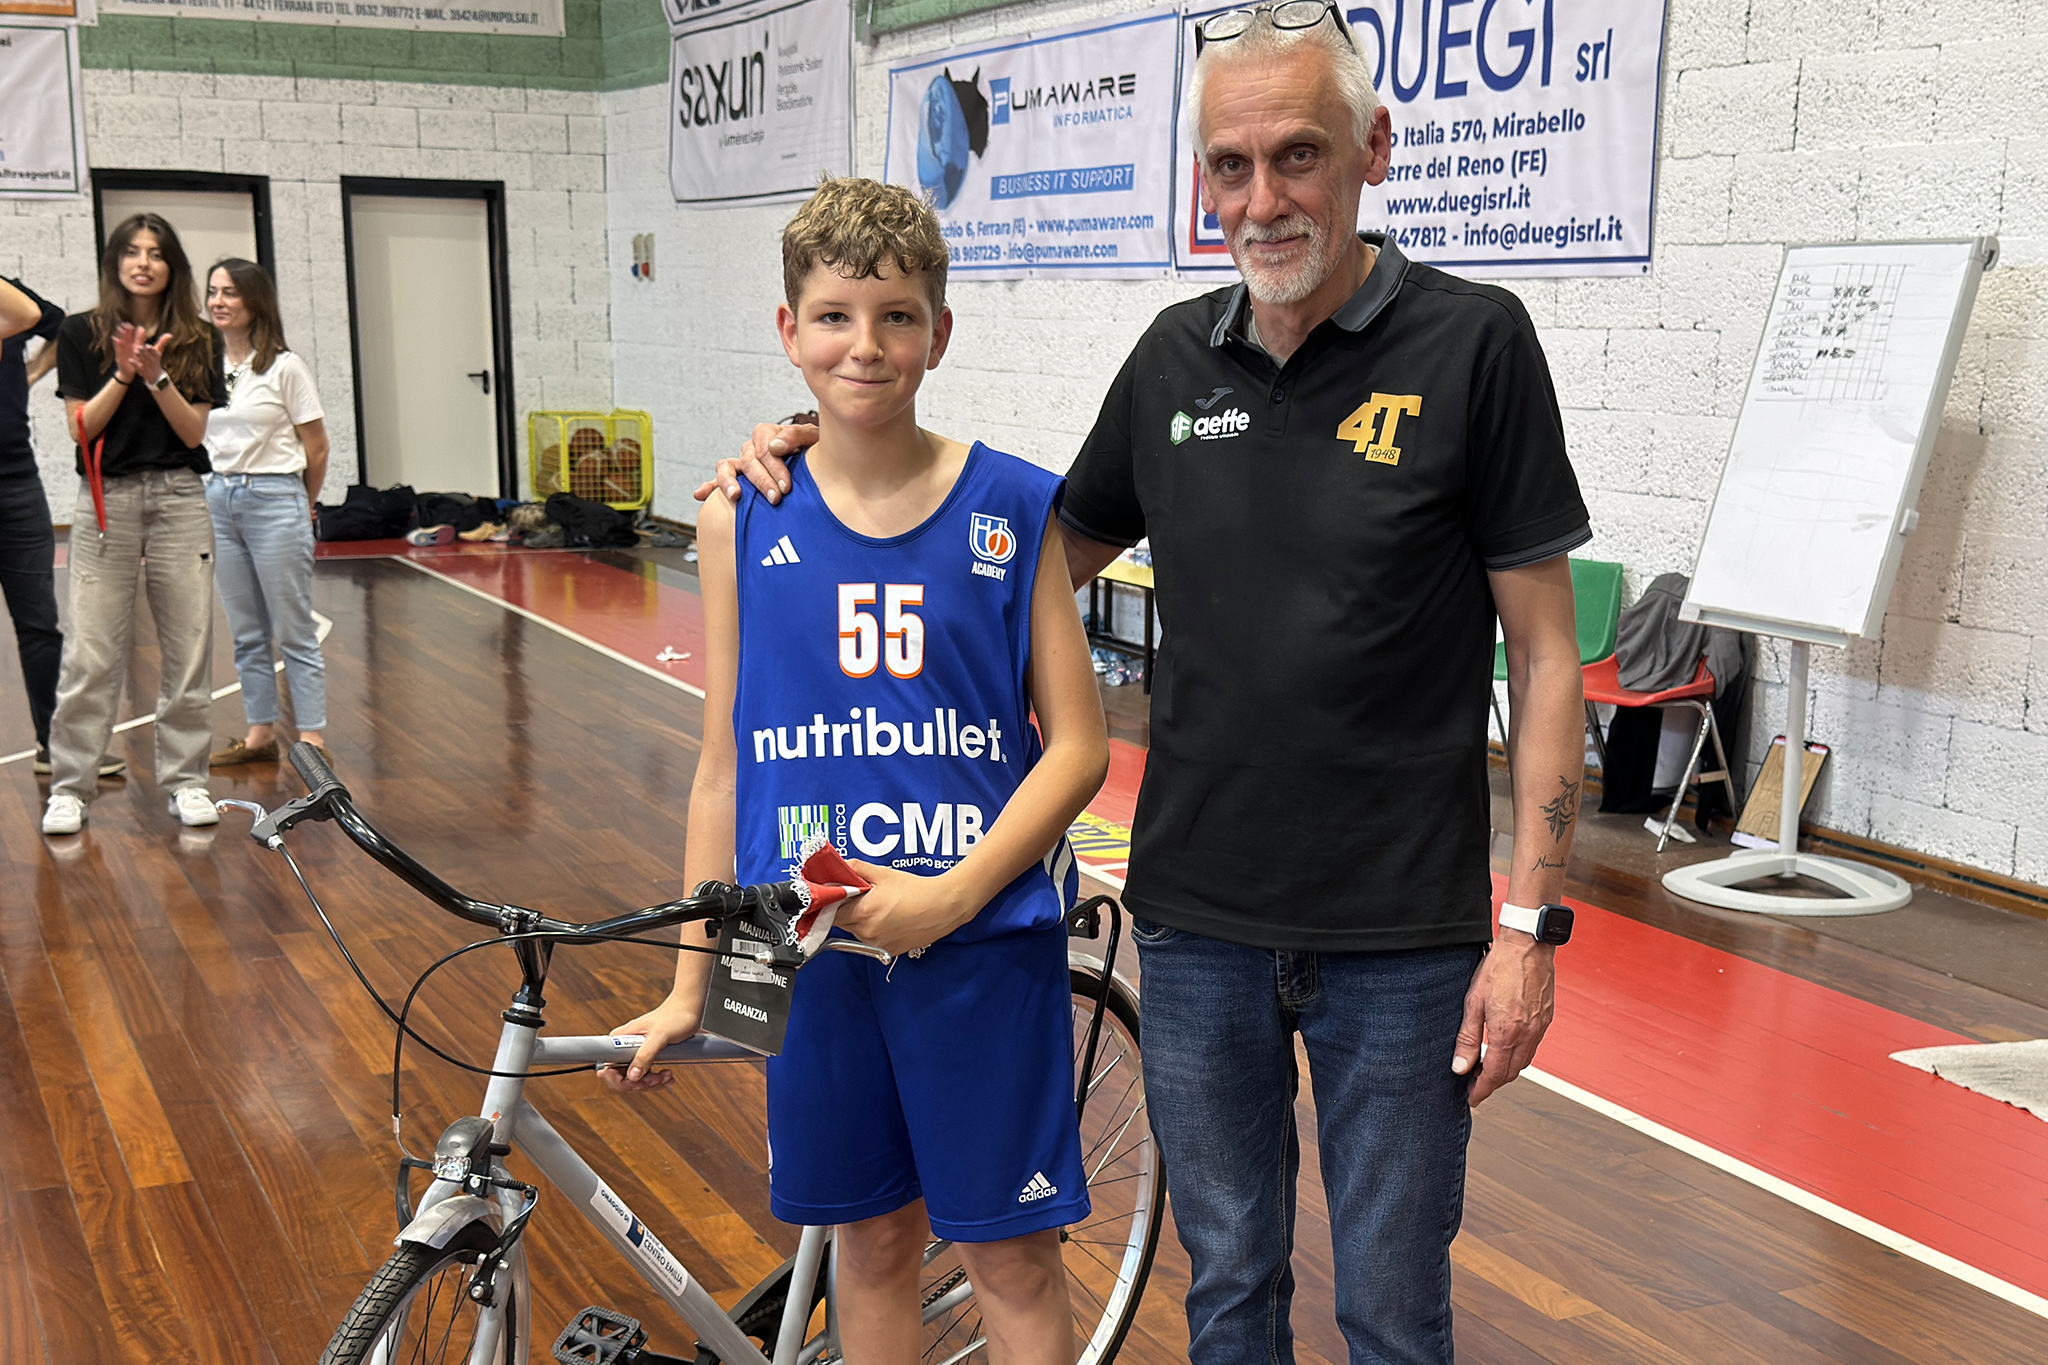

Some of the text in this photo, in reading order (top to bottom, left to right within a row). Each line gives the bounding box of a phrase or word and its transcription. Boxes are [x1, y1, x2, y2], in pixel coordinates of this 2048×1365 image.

[1575, 28, 1613, 81] srl
[993, 74, 1136, 115] PUMAWARE
[1053, 106, 1133, 127] INFORMATICA
[1404, 121, 1444, 147] Italia
[1451, 119, 1487, 143] 570,
[1493, 108, 1586, 138] Mirabello
[999, 167, 1132, 195] BUSINESS IT SUPPORT
[1387, 147, 1547, 182] erre del Reno (FE)
[1387, 184, 1531, 216] www.duegisrl.it
[977, 220, 1011, 238] Ferrara
[1036, 214, 1154, 236] www.pumaware.com
[1464, 215, 1622, 250] info@duegisrl.it
[1008, 242, 1118, 263] info@pumaware.com
[1193, 407, 1250, 436] aeffe
[1369, 448, 1397, 460] 1948
[971, 561, 1006, 581] ACADEMY
[838, 583, 925, 679] 55
[753, 707, 1001, 763] nutribullet
[836, 803, 848, 857] Banca
[850, 802, 985, 857] CMB
[892, 857, 933, 868] GRUPPO
[723, 997, 768, 1023] GARANZIA
[600, 1189, 630, 1223] OMAGGIO DI
[1018, 1186, 1058, 1203] adidas
[643, 1239, 665, 1266] CENTRO
[665, 1261, 683, 1285] EMILIA
